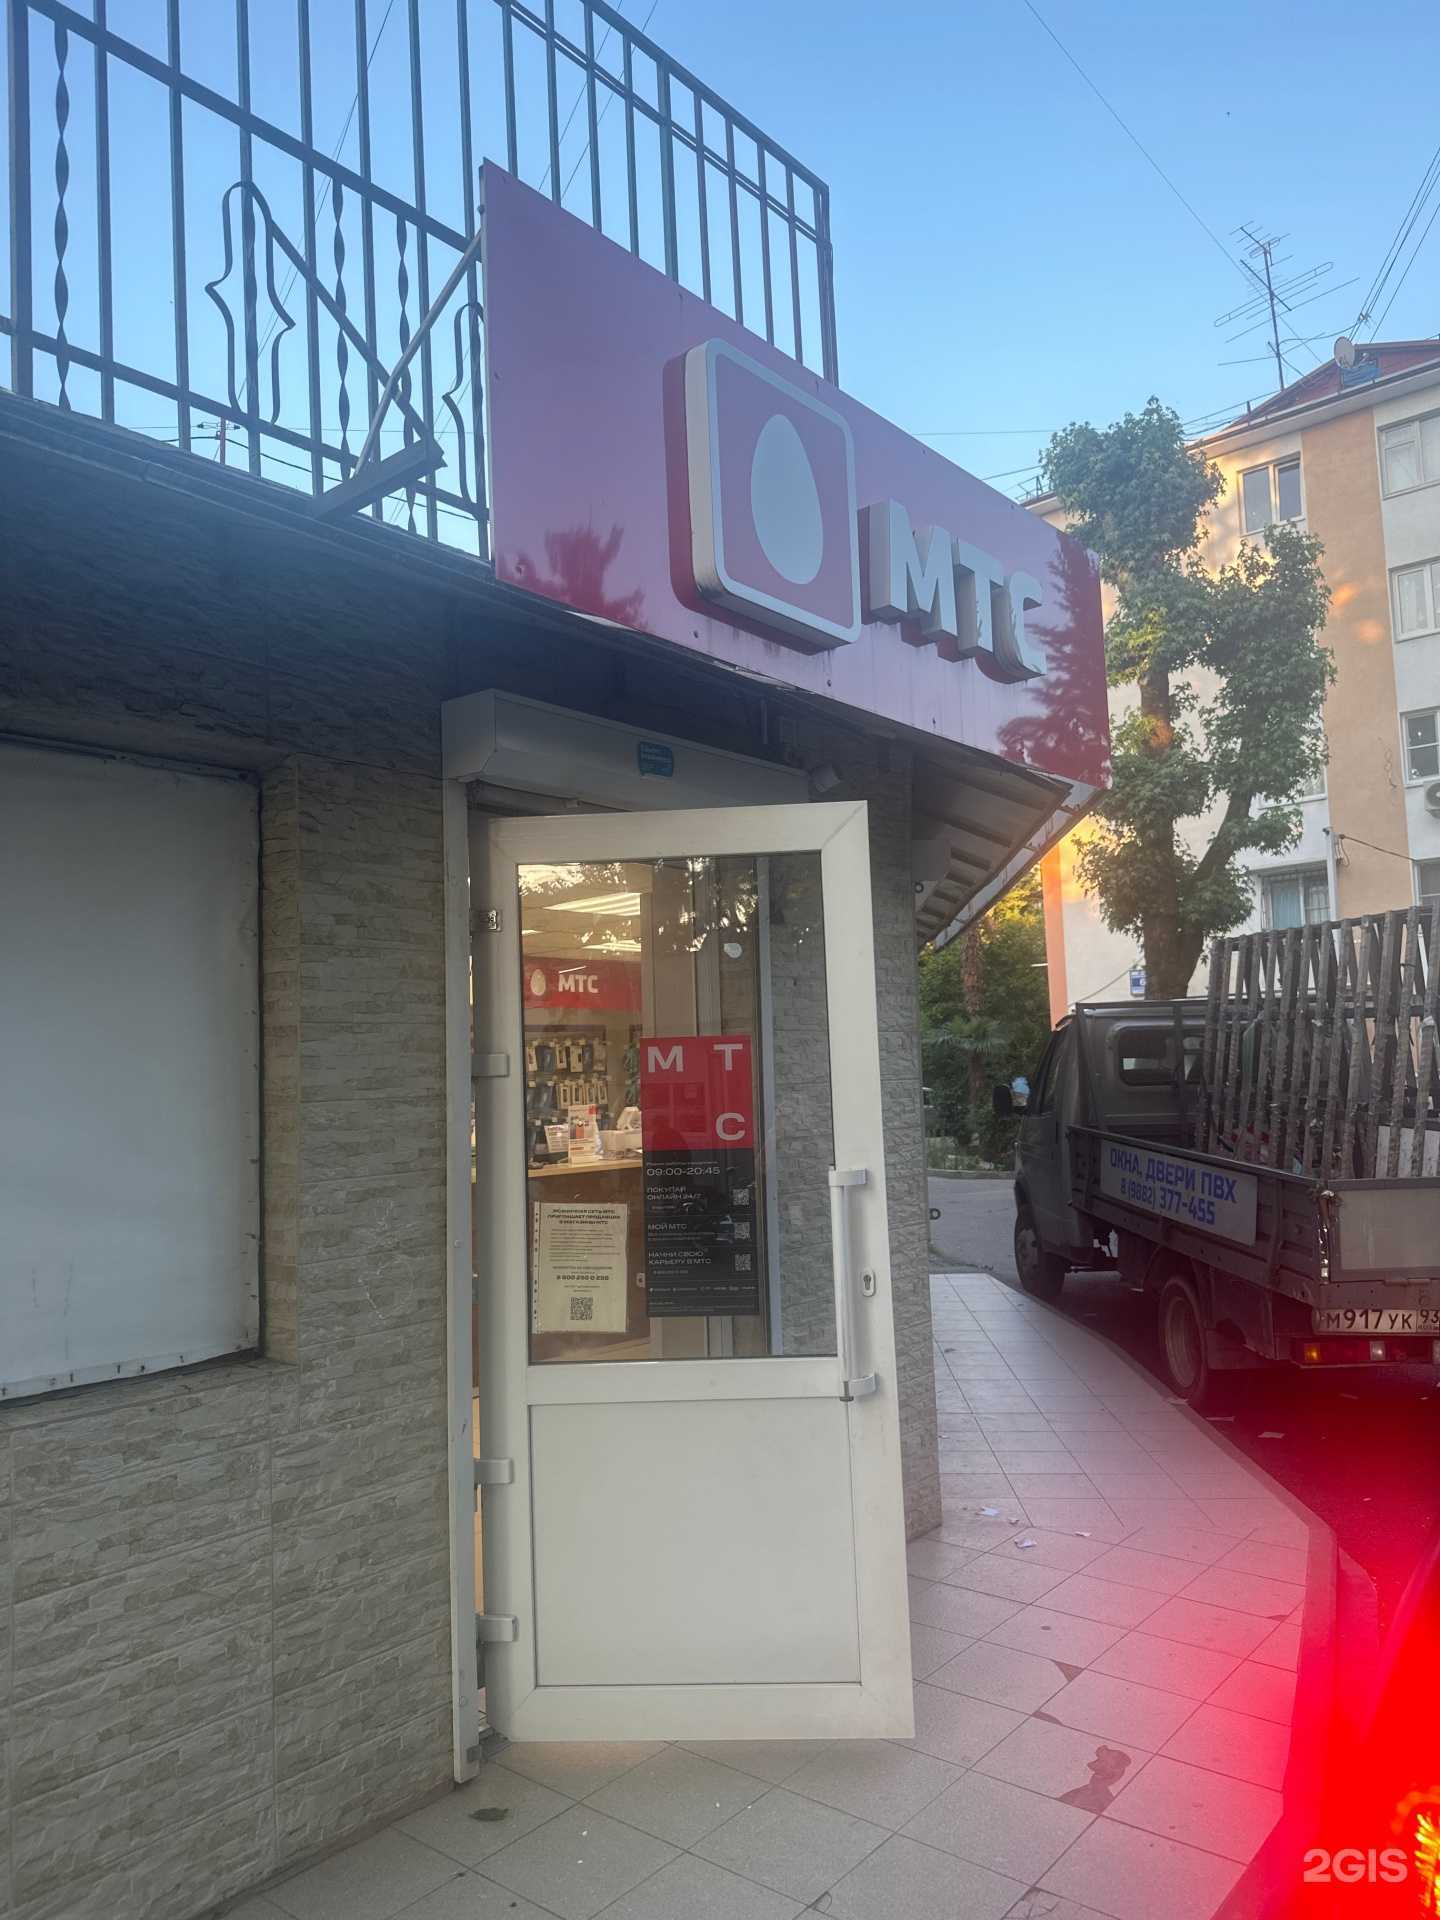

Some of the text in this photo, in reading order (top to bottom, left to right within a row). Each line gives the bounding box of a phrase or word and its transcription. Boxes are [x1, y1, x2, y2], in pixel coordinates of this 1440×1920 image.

[872, 498, 1048, 677] МТС
[558, 974, 599, 993] МТС
[646, 1166, 721, 1176] 09:00-20:45
[1145, 1157, 1195, 1191] ДВЕРИ
[1201, 1171, 1238, 1204] ПВХ
[1120, 1177, 1127, 1195] 8
[1159, 1187, 1216, 1225] 377-455
[647, 1222, 688, 1231] МОЙ МТС
[1419, 1308, 1440, 1324] 93
